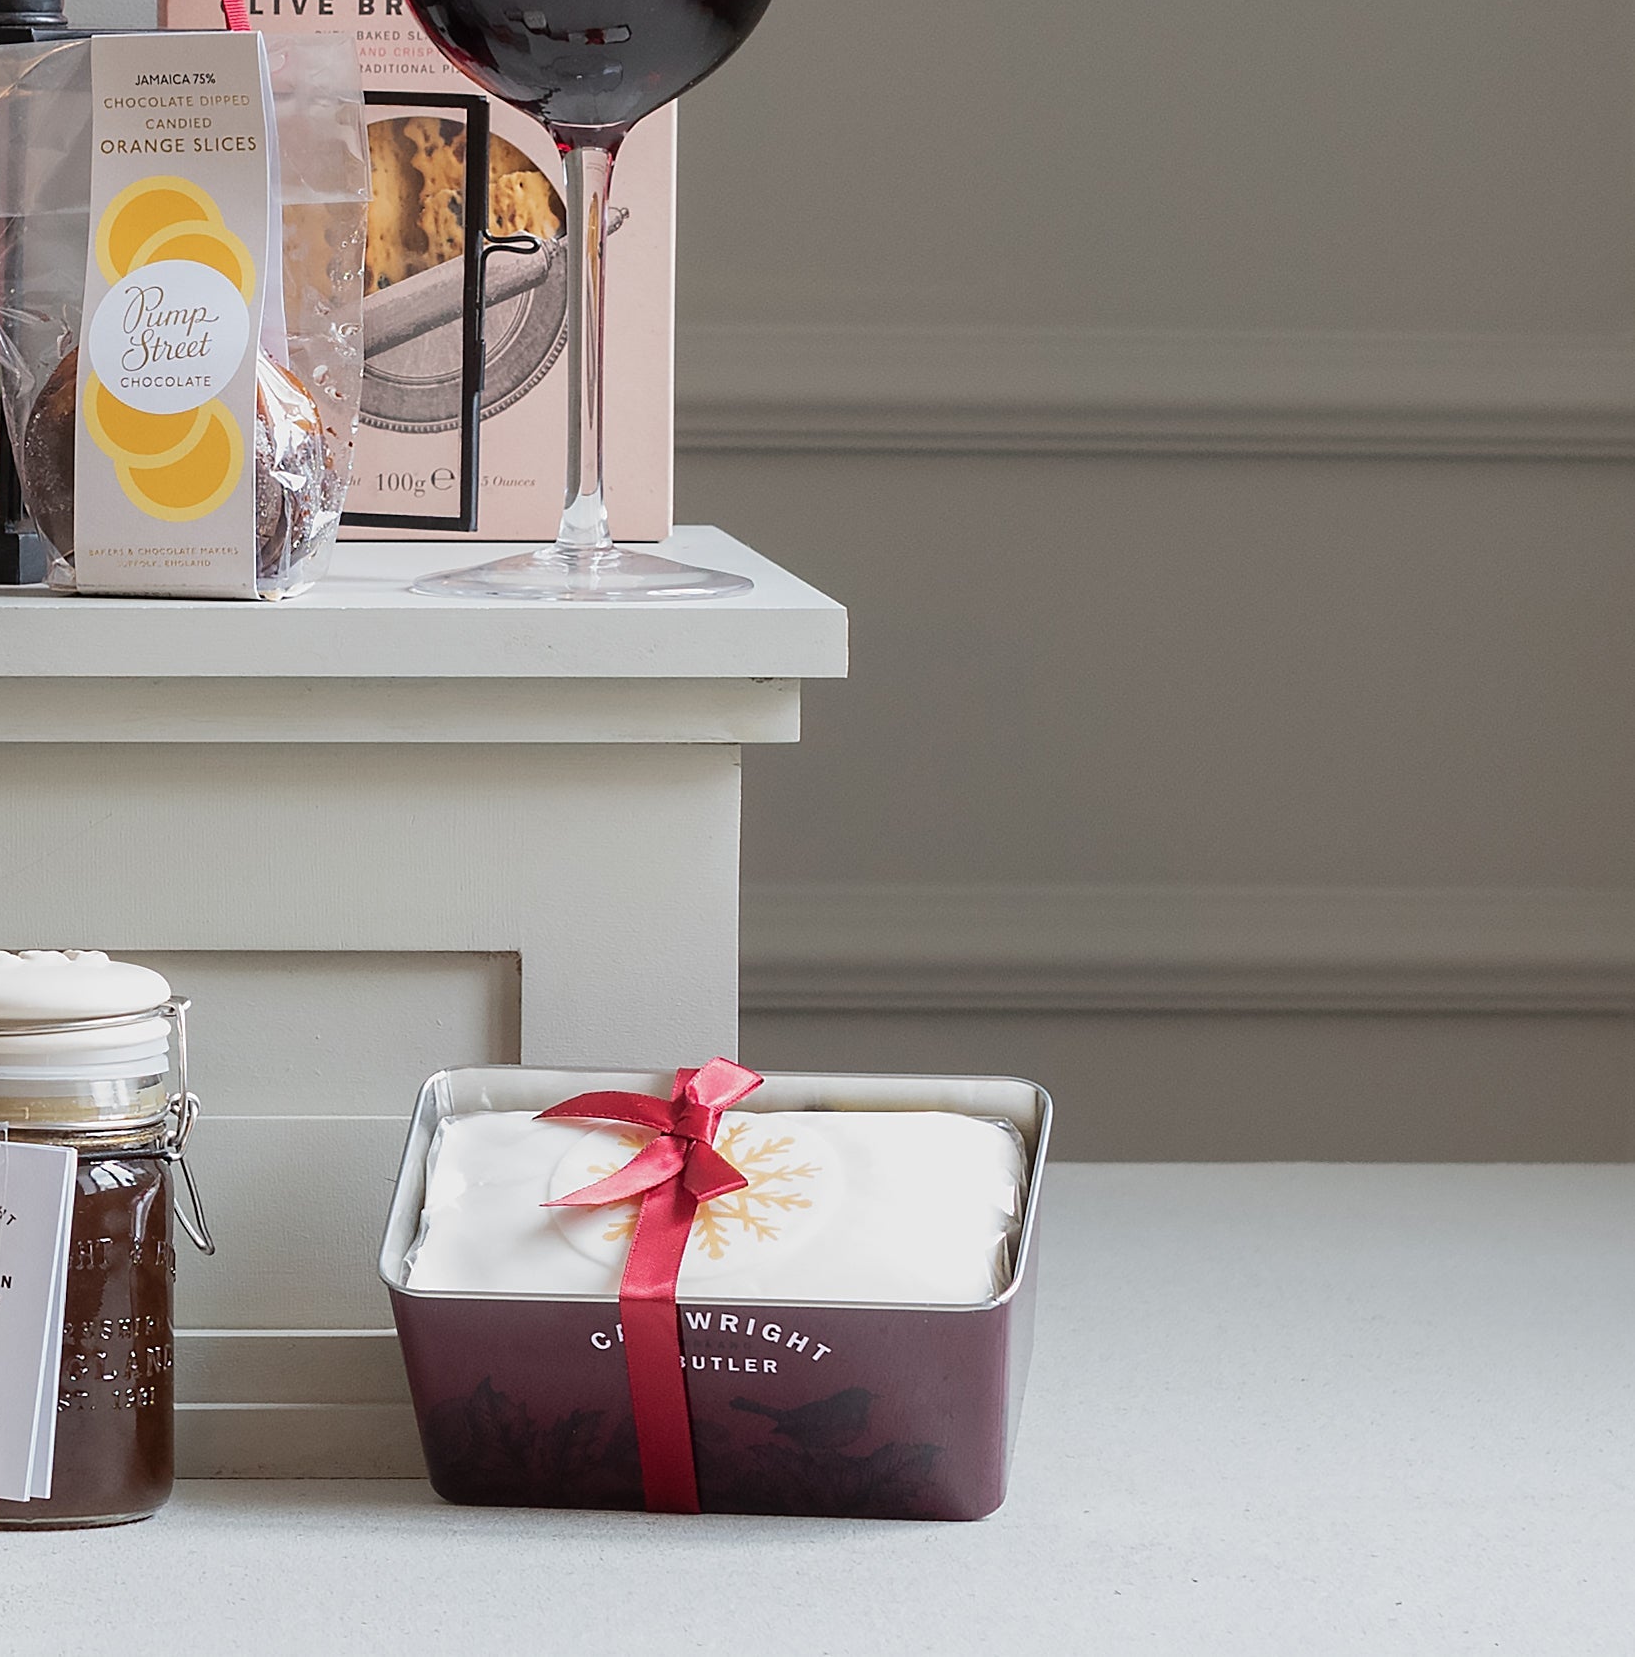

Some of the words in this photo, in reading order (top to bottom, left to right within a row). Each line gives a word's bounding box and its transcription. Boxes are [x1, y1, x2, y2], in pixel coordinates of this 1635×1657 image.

[357, 31, 401, 40] BAKED
[360, 47, 386, 57] AND
[135, 74, 190, 86] JAMAICA
[193, 73, 216, 84] 75%
[104, 96, 193, 108] CHOCOLATE
[200, 95, 250, 106] DIPPED
[146, 118, 212, 130] CANDIED
[101, 138, 185, 154] ORANGE
[194, 136, 256, 152] SLICES
[123, 286, 219, 337] Pump
[122, 329, 212, 372] Street
[121, 376, 211, 388] CHOCOLATE
[376, 472, 426, 498] 100g
[493, 476, 536, 487] Ounces
[138, 547, 195, 555] CHOCOLATE
[200, 547, 238, 555] MAKERS
[590, 1311, 832, 1362] CWRIGHT
